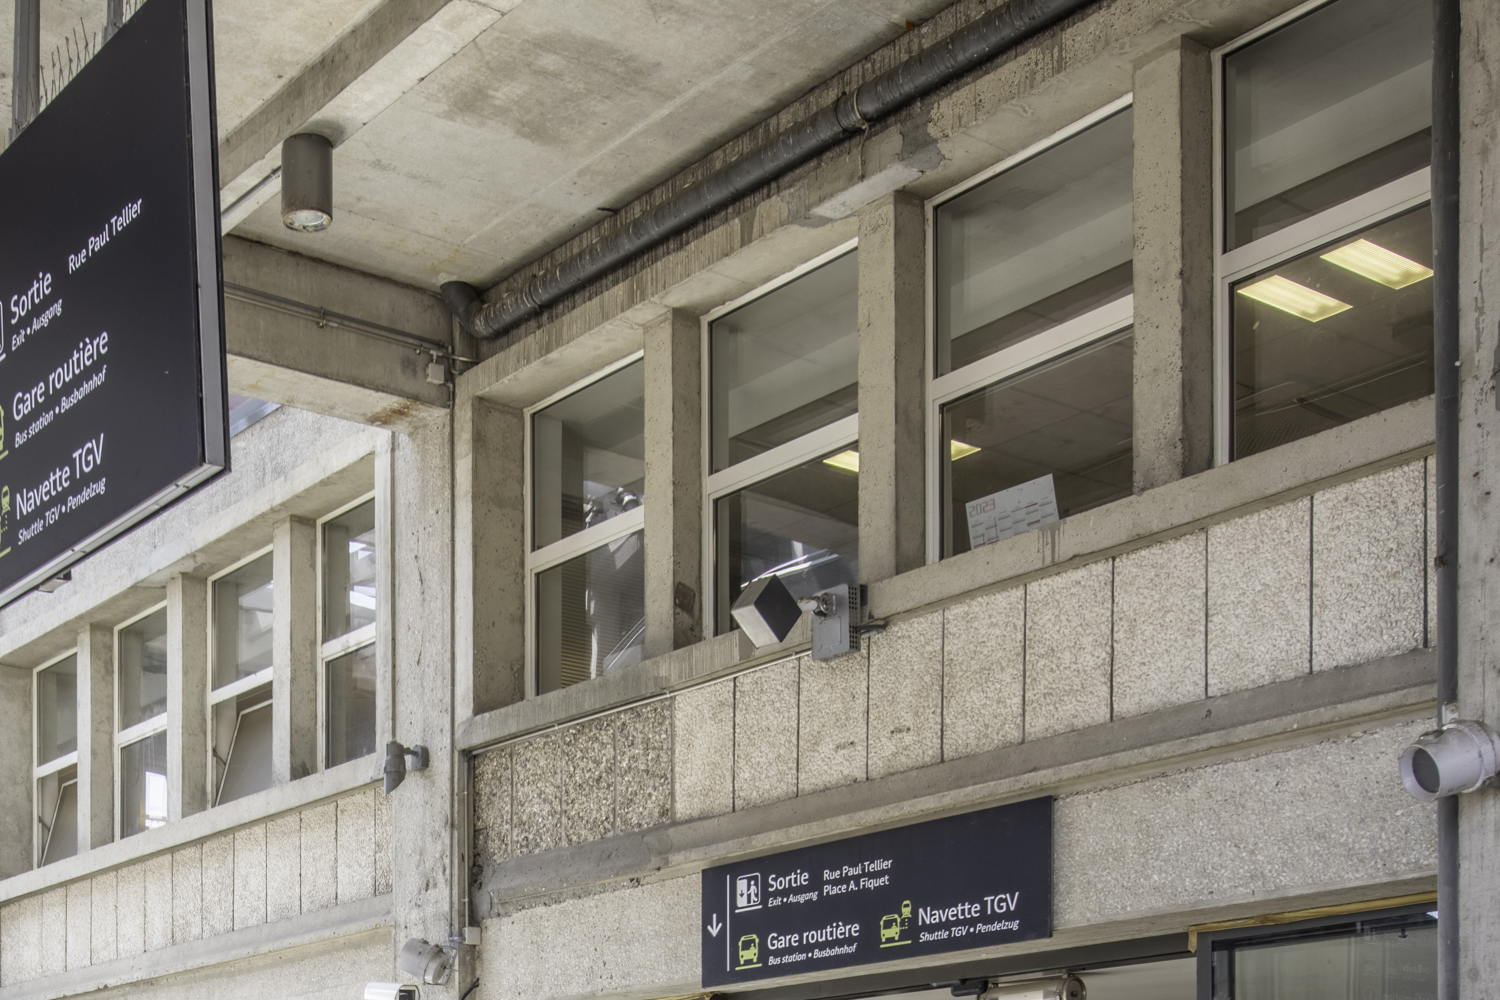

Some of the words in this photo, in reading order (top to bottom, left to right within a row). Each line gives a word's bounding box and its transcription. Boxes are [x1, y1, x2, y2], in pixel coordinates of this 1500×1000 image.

[68, 248, 87, 275] Rue
[88, 223, 110, 257] Paul
[110, 198, 142, 236] Tellier
[10, 271, 52, 325] Sortie
[11, 328, 25, 351] Exit
[31, 298, 62, 335] Ausgang
[13, 381, 45, 421] Gare
[49, 331, 109, 395] routière
[15, 429, 28, 448] Bus
[28, 410, 54, 438] station
[60, 364, 107, 413] Busbahnhof
[16, 465, 70, 520] Navette
[72, 432, 104, 479] TGV
[18, 518, 44, 545] Shuttle
[45, 504, 60, 527] TGV
[67, 477, 106, 513] Pendelzug
[968, 498, 996, 518] 2023
[768, 869, 809, 892] Sortie
[824, 870, 840, 881] Rue
[842, 863, 862, 877] Paul
[863, 858, 893, 872] Tellier
[768, 897, 782, 907] Exit
[788, 891, 818, 904] Ausgang
[824, 884, 846, 896] Place
[848, 880, 858, 892] A.
[860, 875, 889, 890] Fiquet
[918, 902, 980, 926] Navette
[984, 892, 1019, 915] TGV
[768, 933, 799, 950] Gare
[803, 922, 860, 944] routière
[919, 929, 949, 942] Shuttle
[951, 925, 968, 937] TGV
[976, 920, 1020, 934] Pendelzug
[768, 956, 781, 966] Bus
[782, 952, 806, 963] station
[813, 943, 858, 958] Busbahnhof
